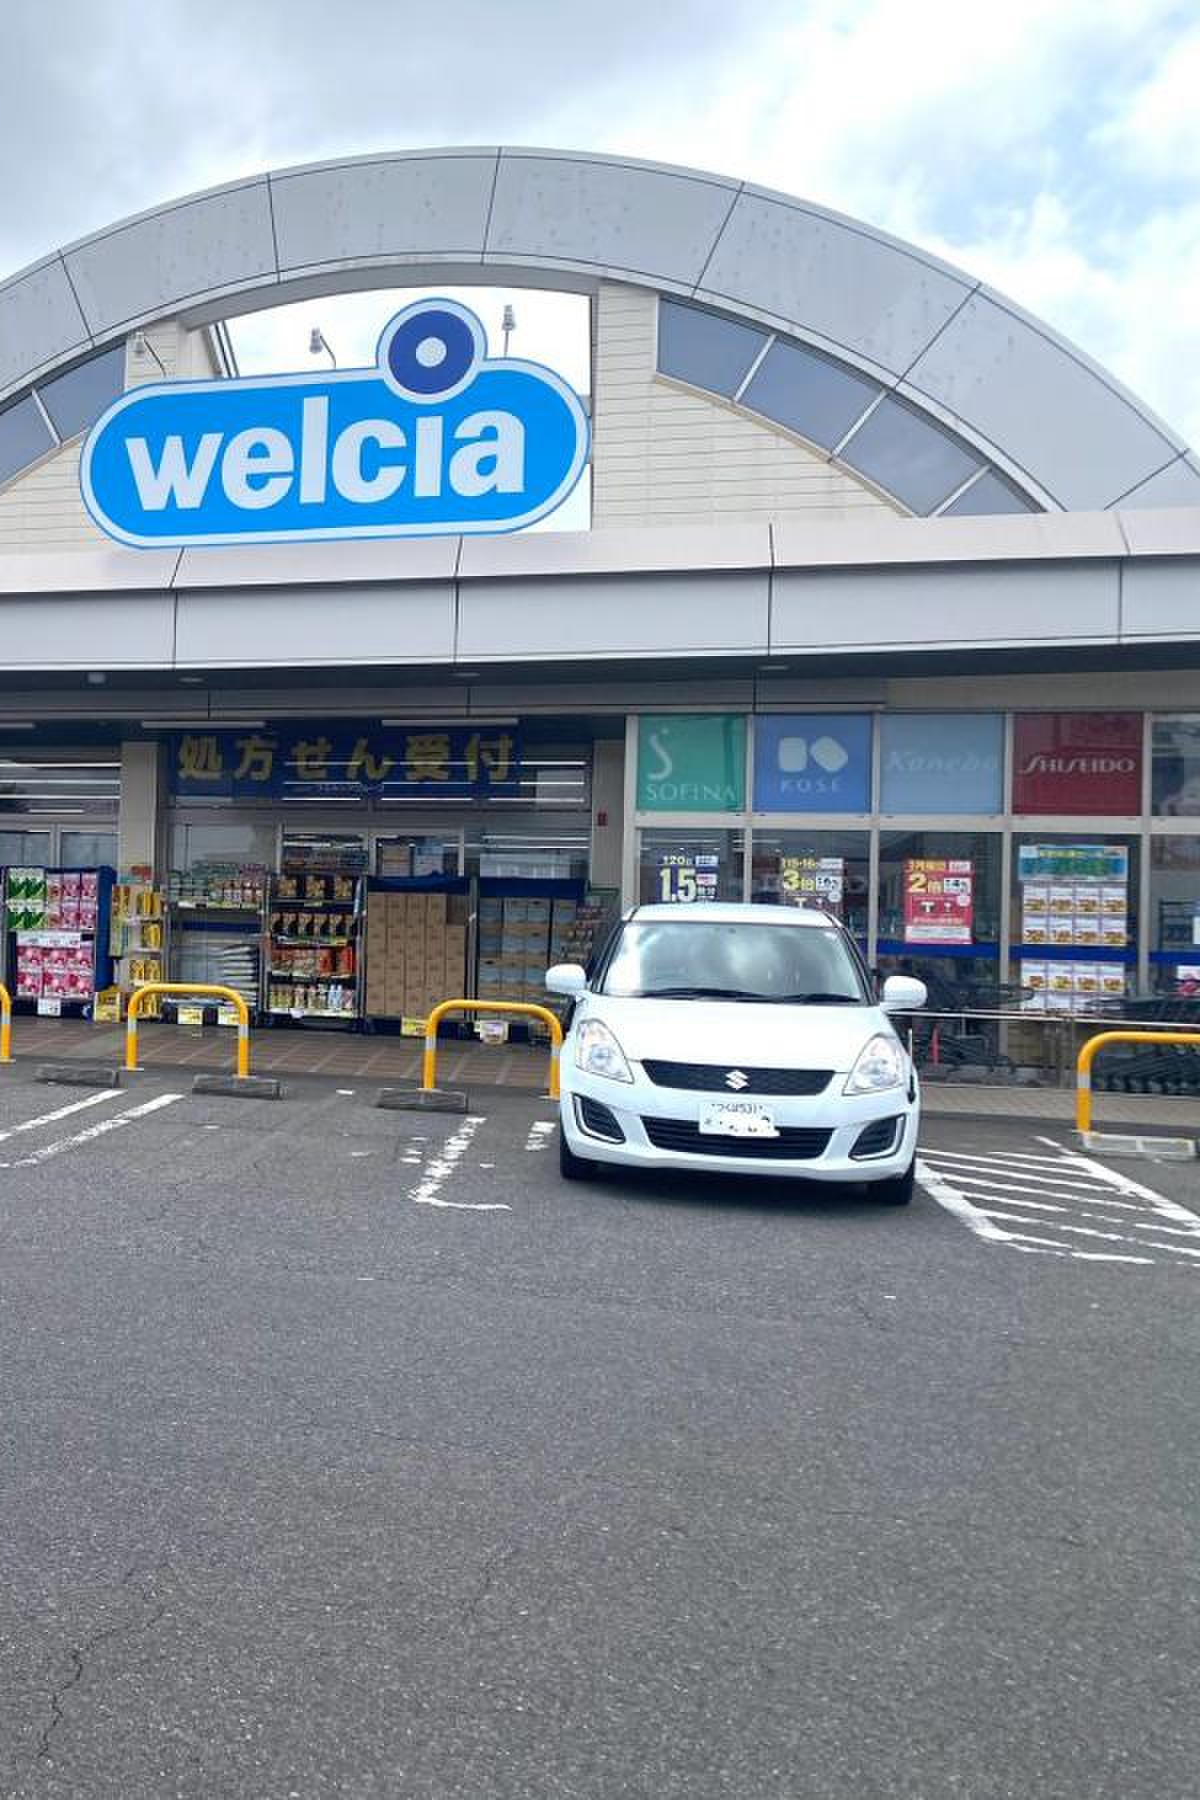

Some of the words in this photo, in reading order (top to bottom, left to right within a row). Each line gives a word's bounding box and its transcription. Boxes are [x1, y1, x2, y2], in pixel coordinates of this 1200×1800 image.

[125, 395, 526, 512] welcia
[177, 733, 513, 781] 処方せん受付
[1018, 755, 1136, 774] SHISEIDO
[645, 783, 736, 801] SOFINA
